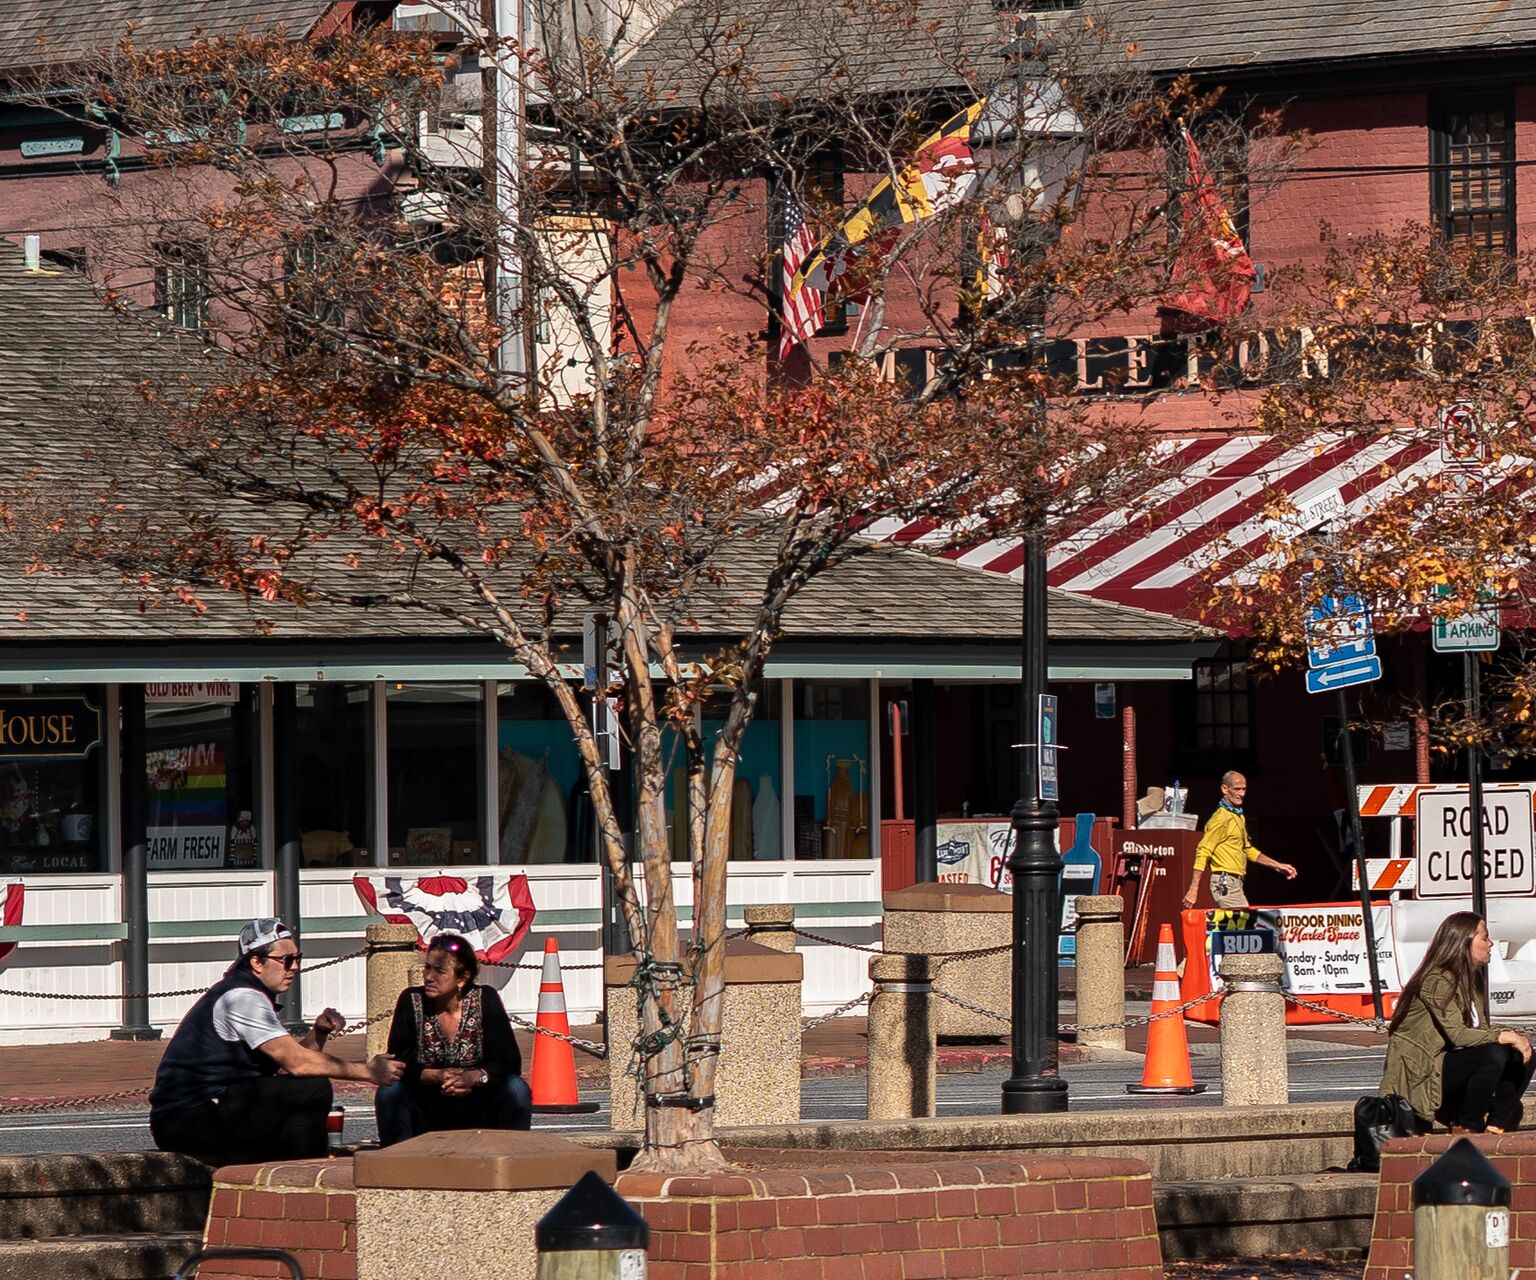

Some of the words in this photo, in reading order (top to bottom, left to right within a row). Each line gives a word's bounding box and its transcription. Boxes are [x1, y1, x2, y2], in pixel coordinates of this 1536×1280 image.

[1308, 493, 1338, 520] STREET
[183, 836, 220, 860] FRESH
[1123, 841, 1174, 856] Middleton
[44, 856, 87, 868] LOCAL
[1276, 914, 1326, 928] OUTDOOR
[1327, 914, 1363, 928] DINING
[1288, 926, 1326, 943] Market
[1326, 926, 1361, 945] Space
[1224, 934, 1263, 954] BUD
[1324, 950, 1360, 965] Sunday
[1294, 965, 1316, 976] 8am
[1323, 964, 1349, 977] 10pm
